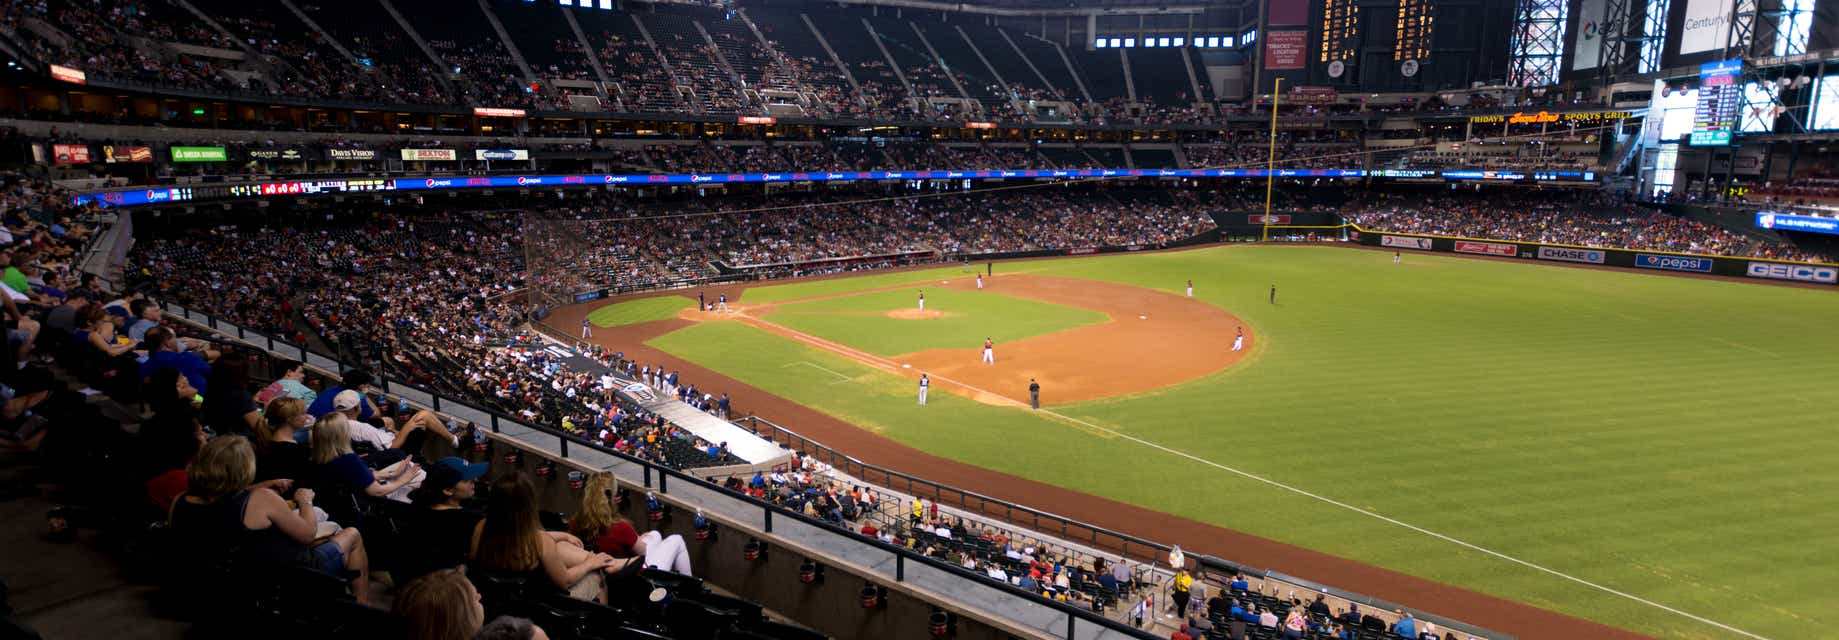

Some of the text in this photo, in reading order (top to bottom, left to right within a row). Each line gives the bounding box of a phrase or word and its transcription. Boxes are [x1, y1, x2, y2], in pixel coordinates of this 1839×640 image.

[1564, 112, 1600, 120] SPORTS
[1604, 111, 1633, 120] GRILL
[1544, 248, 1585, 260] CHASE
[1660, 257, 1701, 269] pepsi
[1749, 262, 1836, 281] GEICO
